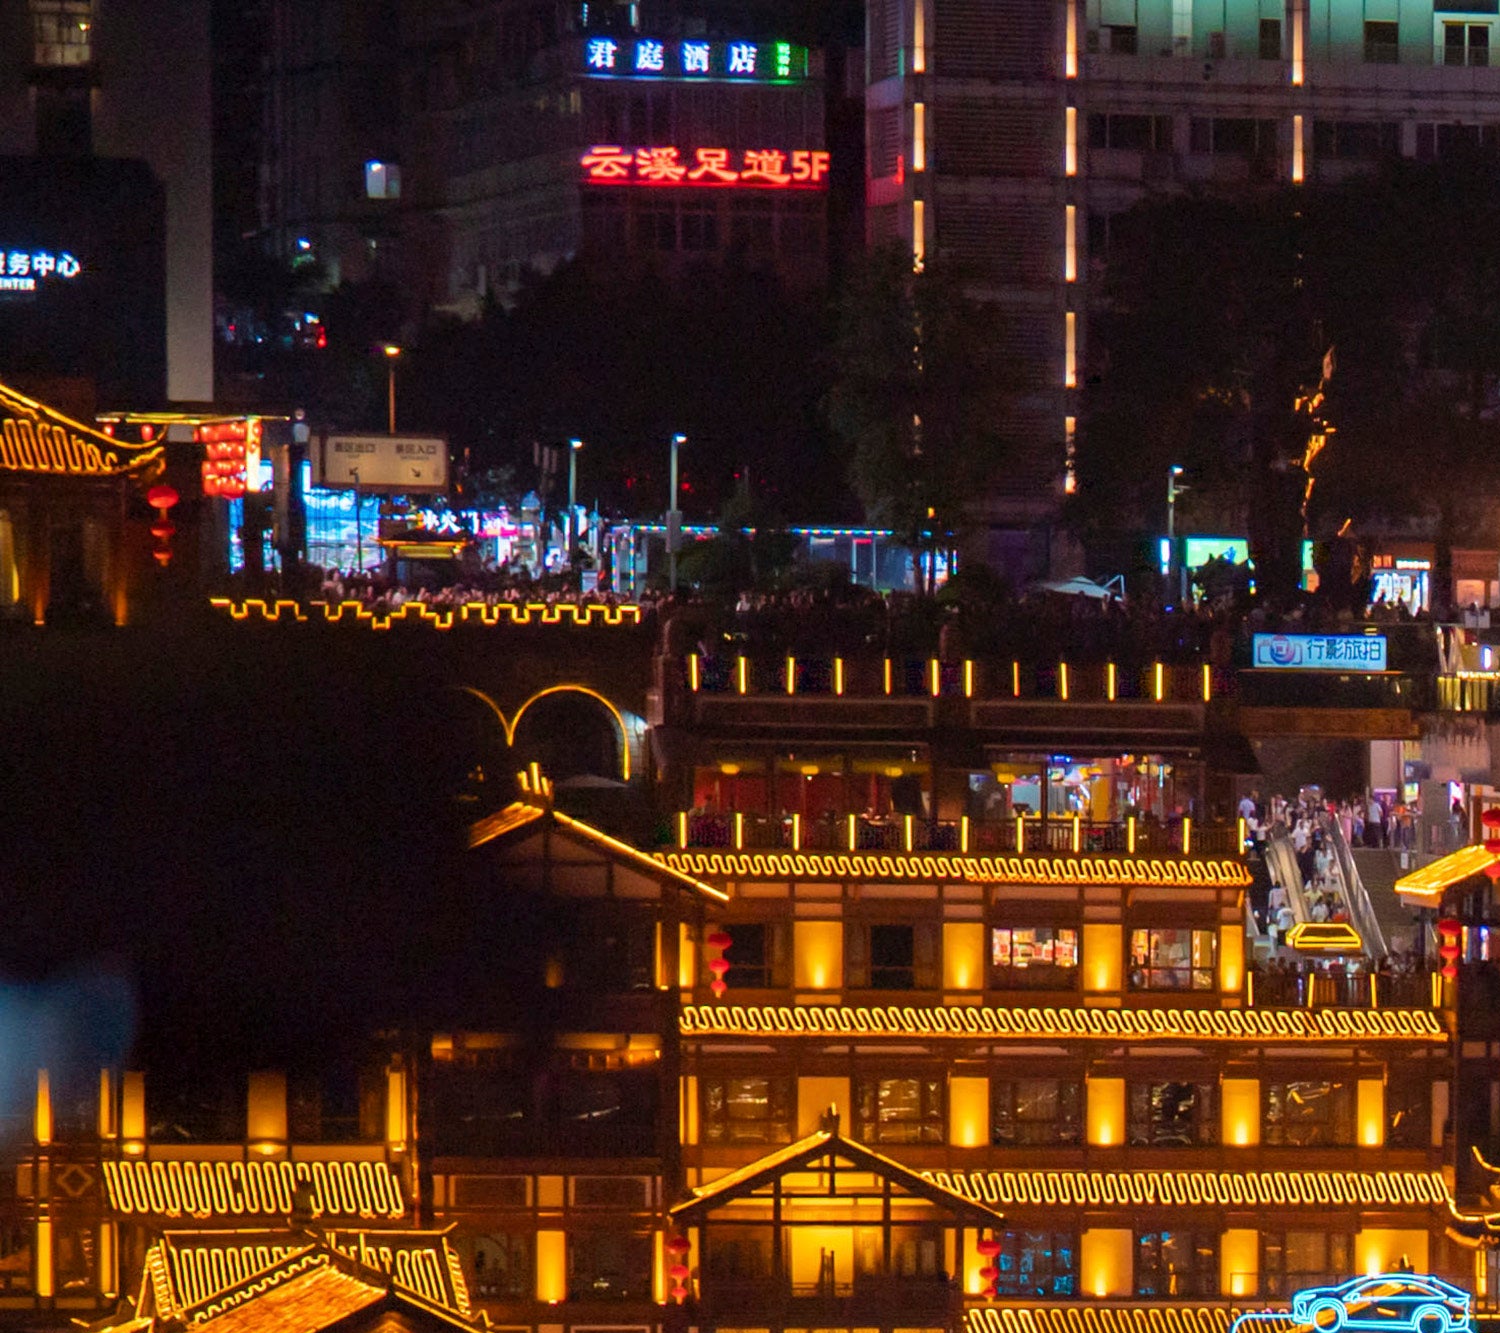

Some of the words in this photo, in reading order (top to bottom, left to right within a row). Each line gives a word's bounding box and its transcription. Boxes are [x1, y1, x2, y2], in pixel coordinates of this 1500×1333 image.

[589, 40, 757, 72] 君庭酒店
[581, 146, 830, 183] 云溪足道5F
[0, 252, 81, 277] 务中心
[1306, 639, 1382, 661] 行影旅拍
